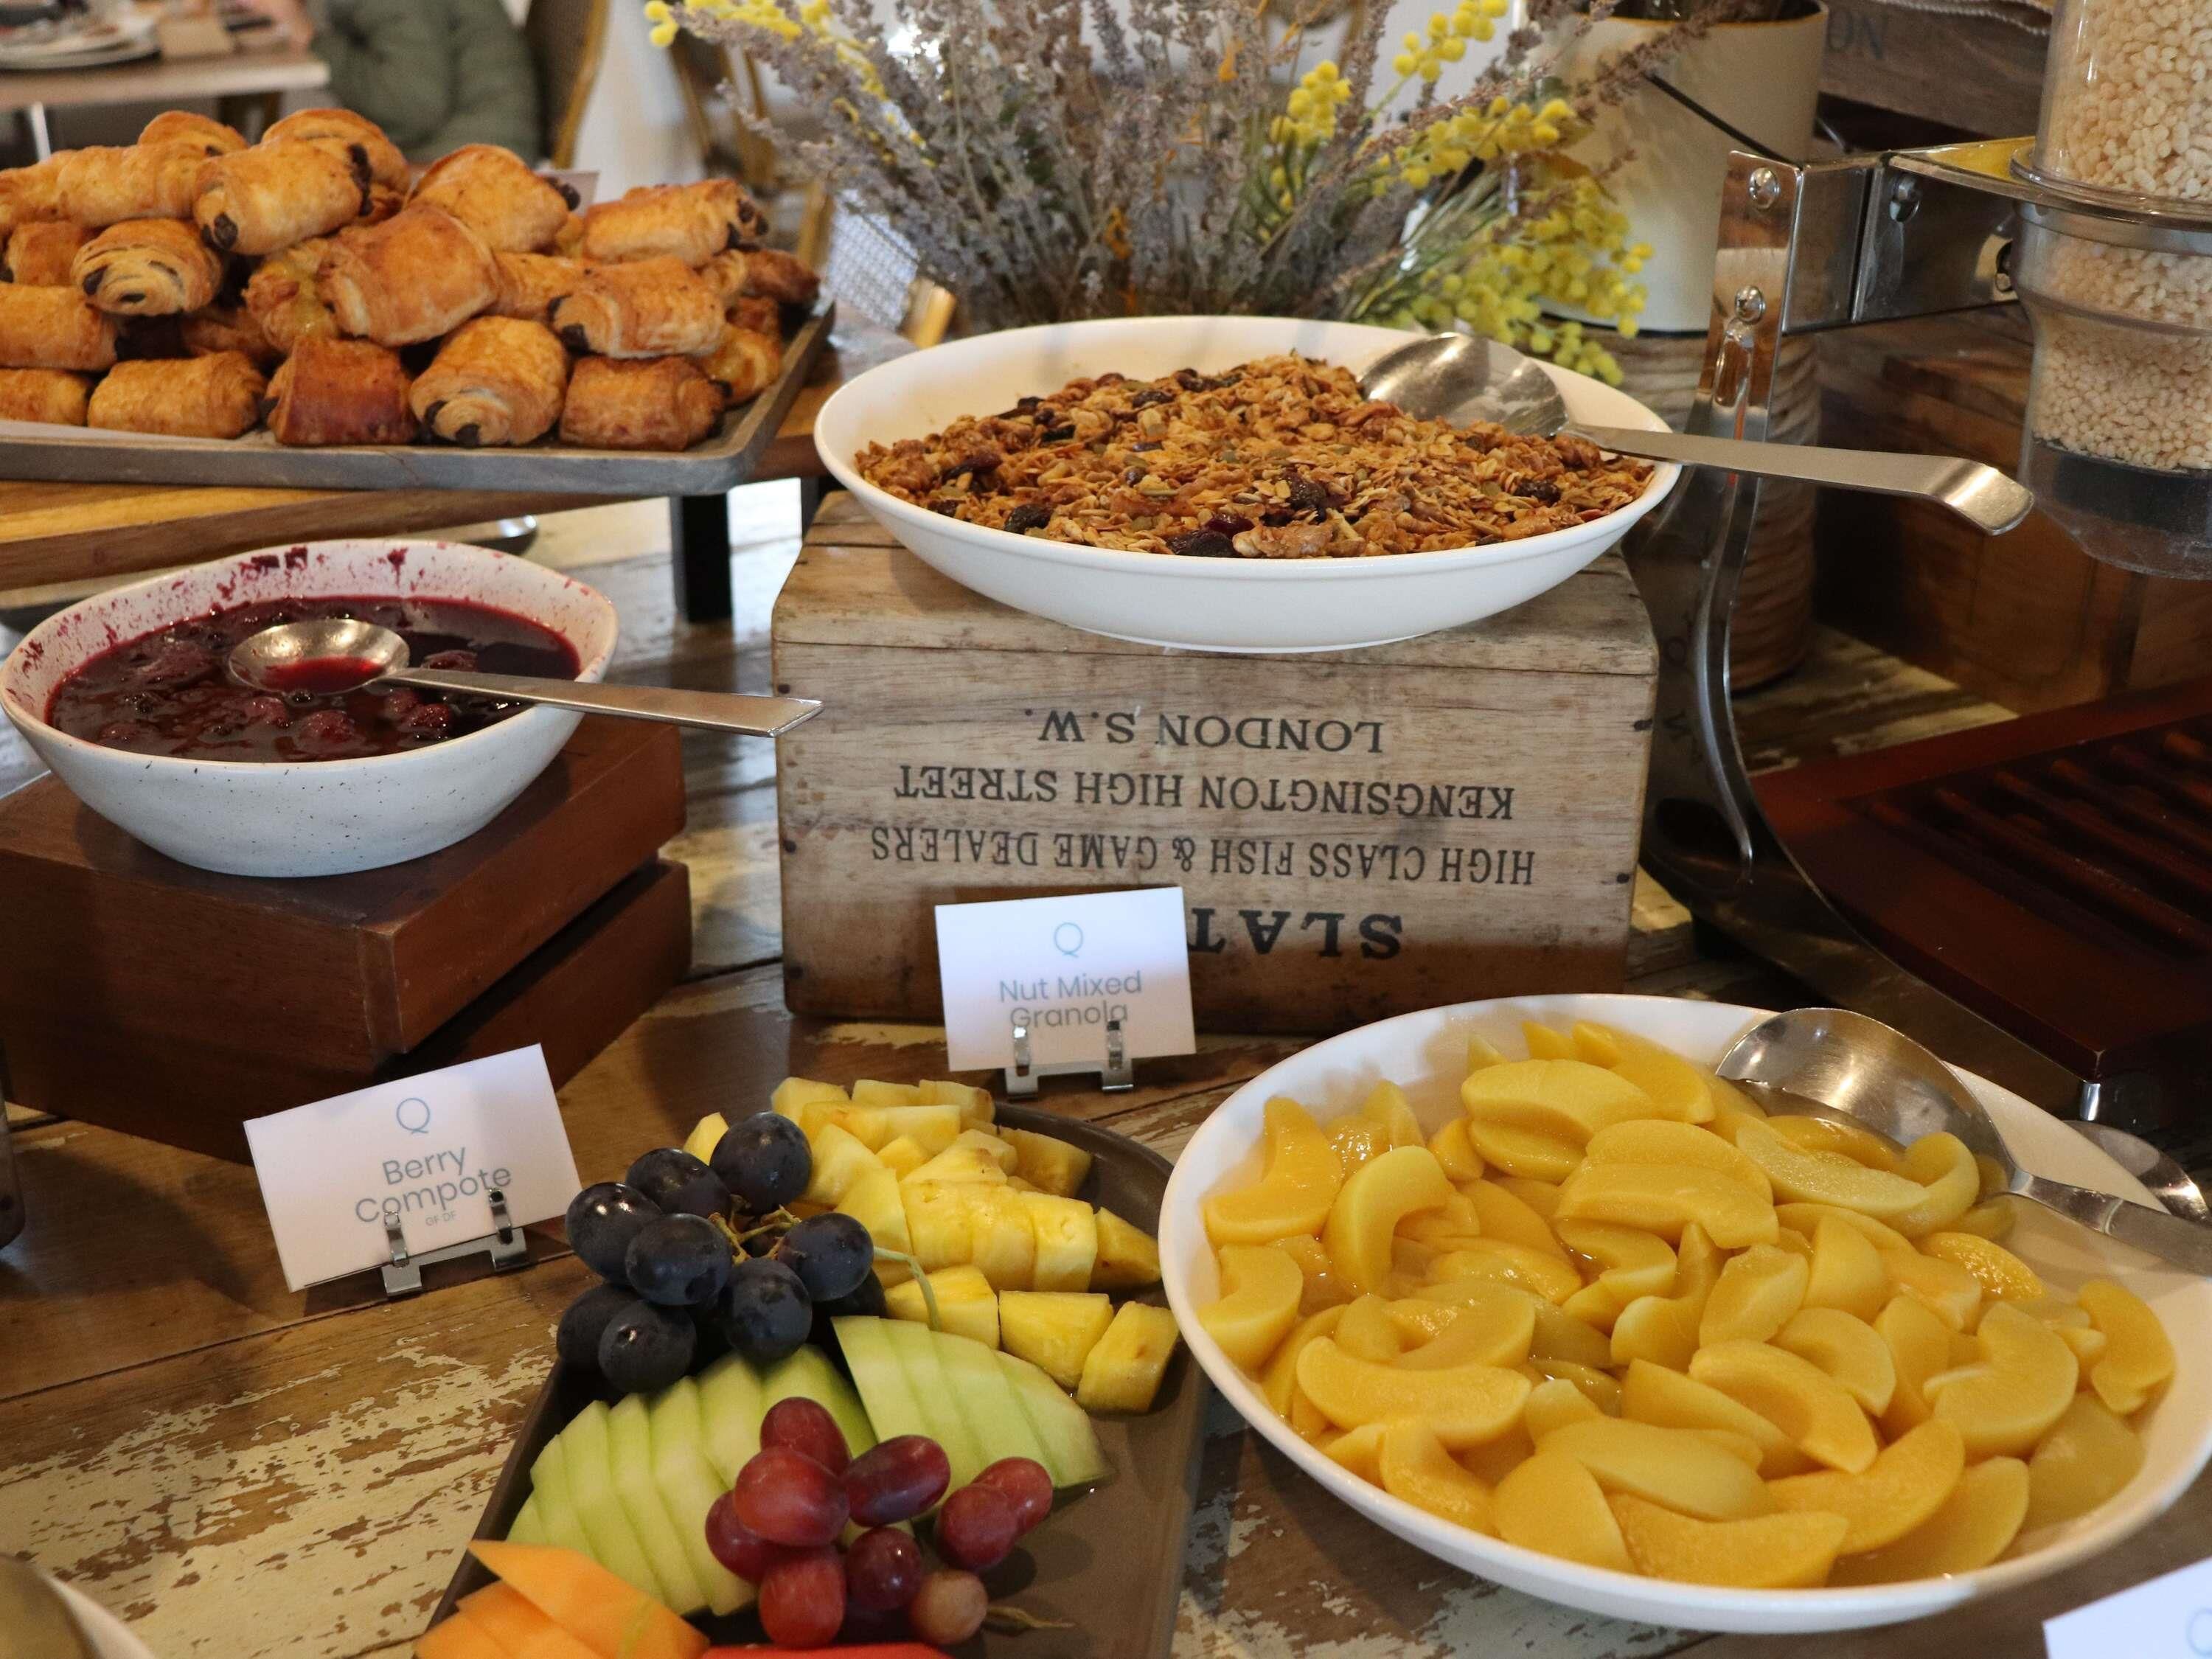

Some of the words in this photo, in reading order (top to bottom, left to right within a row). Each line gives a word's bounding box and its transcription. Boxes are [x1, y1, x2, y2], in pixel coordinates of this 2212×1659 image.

[1156, 714, 1384, 754] LONDON
[894, 765, 1057, 802] STREET
[1074, 771, 1184, 807] HIGH
[1199, 776, 1514, 820] KENGSINGTON
[871, 826, 1039, 866] DEALERS
[1054, 832, 1158, 871] GAME
[1172, 837, 1196, 873] &
[1210, 838, 1295, 876] FISH
[1309, 842, 1425, 881] CLASS
[1439, 847, 1535, 886] HIGH
[1053, 922, 1084, 959] Q
[998, 978, 1049, 1003] Nut
[1057, 970, 1142, 998] Mixed
[1009, 1000, 1128, 1029] Granola
[396, 1097, 431, 1135] Q
[382, 1147, 467, 1186] Berry
[355, 1166, 512, 1223] Compote
